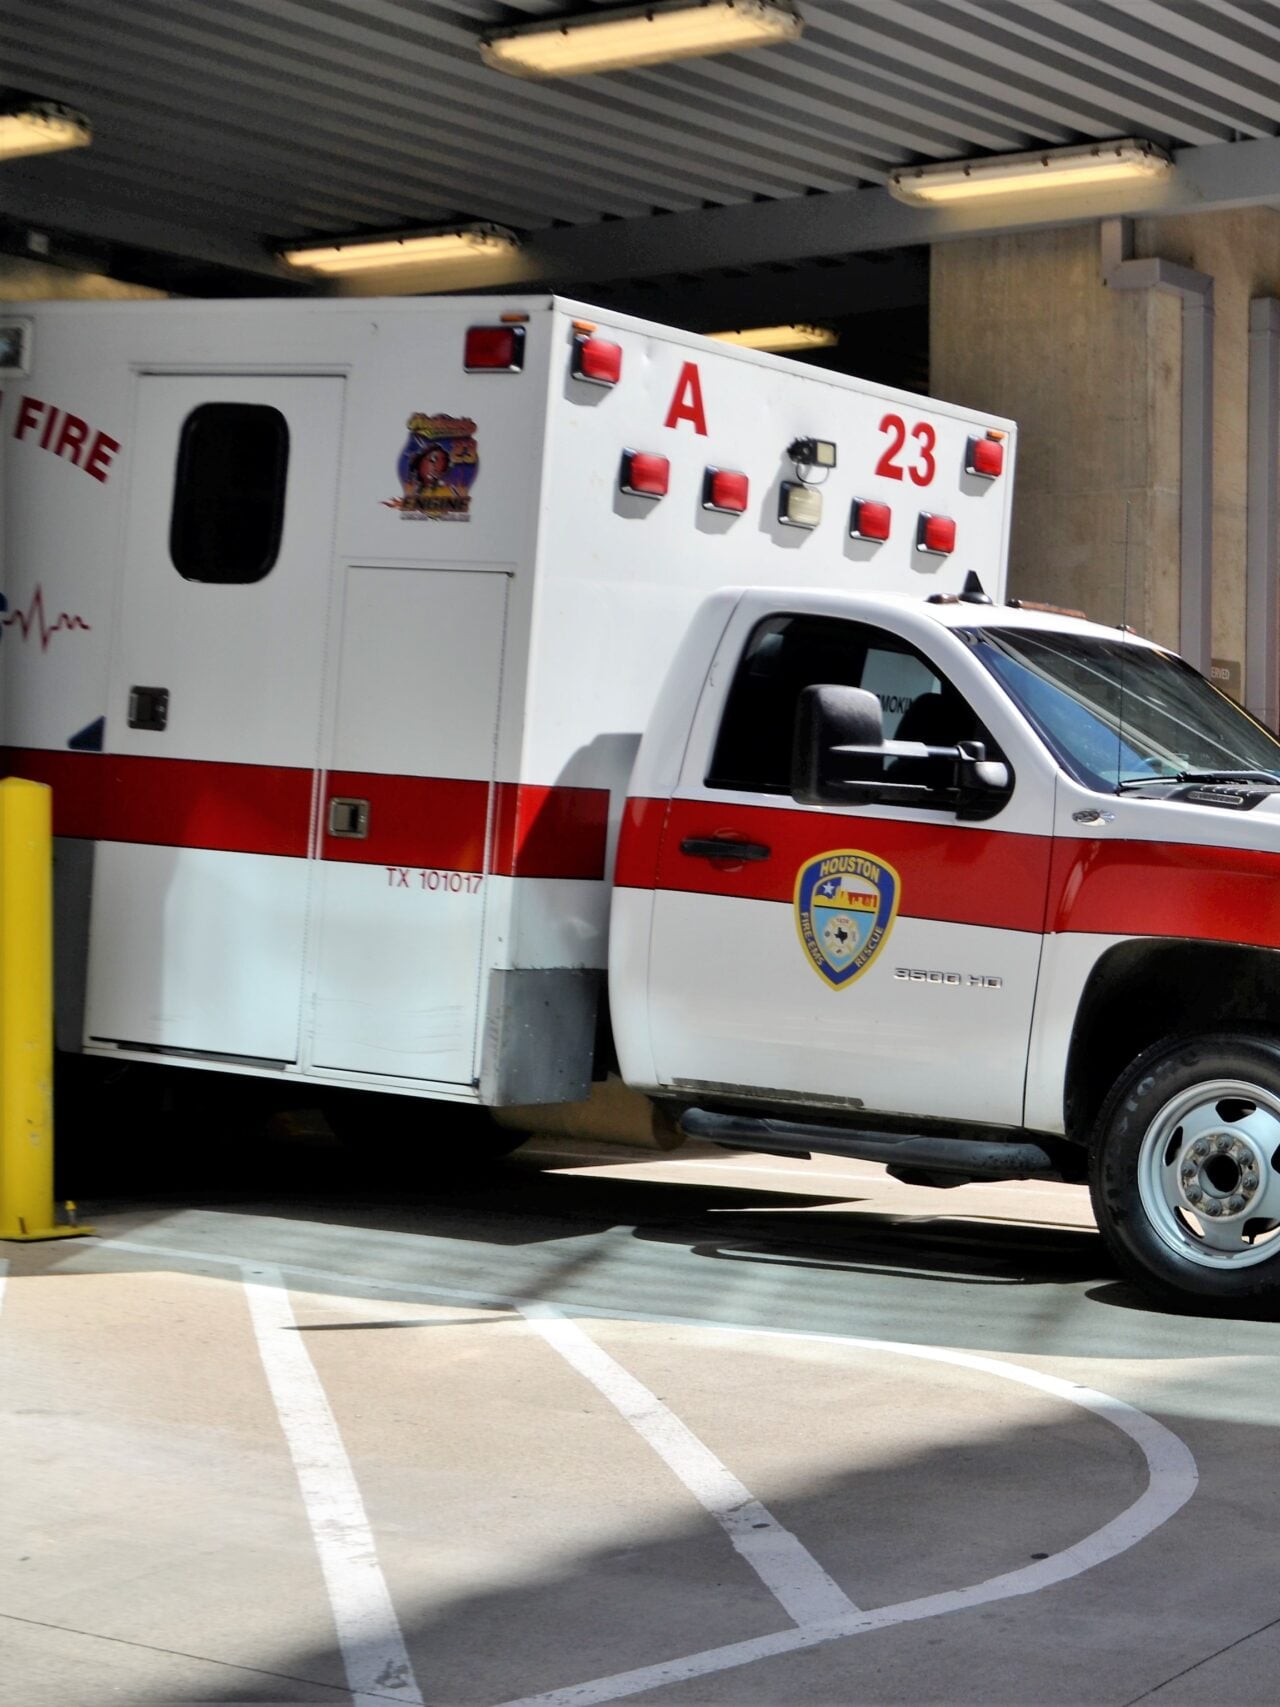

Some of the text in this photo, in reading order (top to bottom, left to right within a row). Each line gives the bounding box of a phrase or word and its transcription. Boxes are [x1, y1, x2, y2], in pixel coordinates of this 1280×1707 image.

[14, 395, 122, 484] FIRE
[664, 361, 936, 487] A 23
[386, 867, 483, 894] TX 101017
[819, 856, 880, 883] HOUSTON
[853, 926, 884, 968] RESCUE
[894, 967, 1003, 989] 3500 HD
